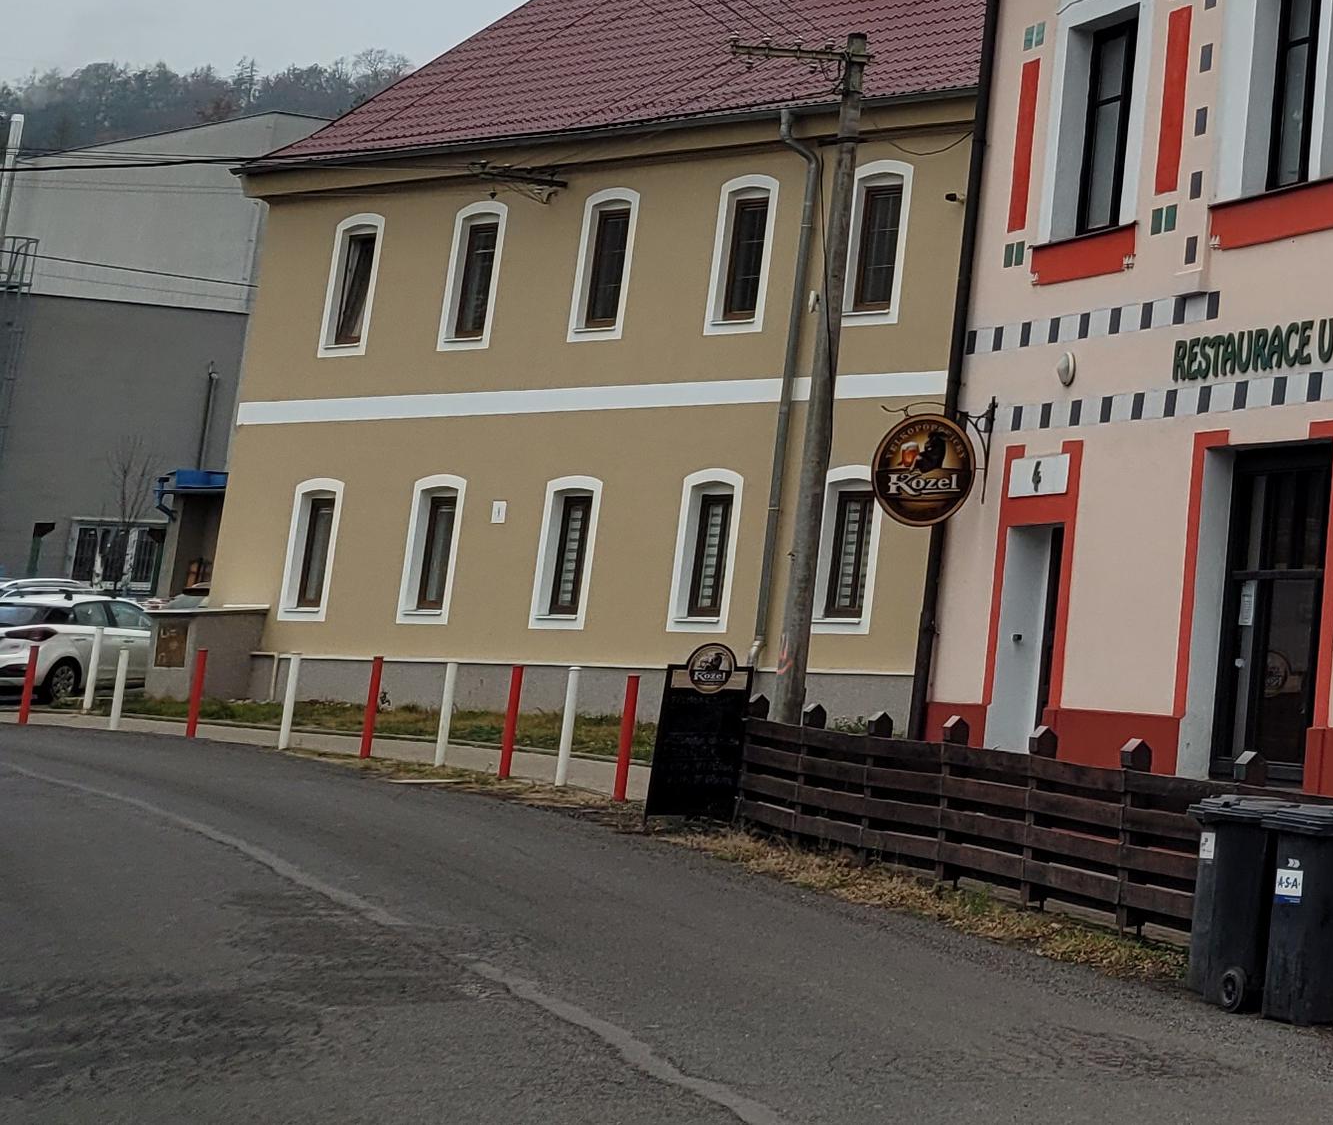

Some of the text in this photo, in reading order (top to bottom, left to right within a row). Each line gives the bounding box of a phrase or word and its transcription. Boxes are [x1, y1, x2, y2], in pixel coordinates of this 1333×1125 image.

[1172, 320, 1314, 382] RESTAURACE
[886, 474, 960, 495] Kozel
[693, 671, 726, 681] Kozel
